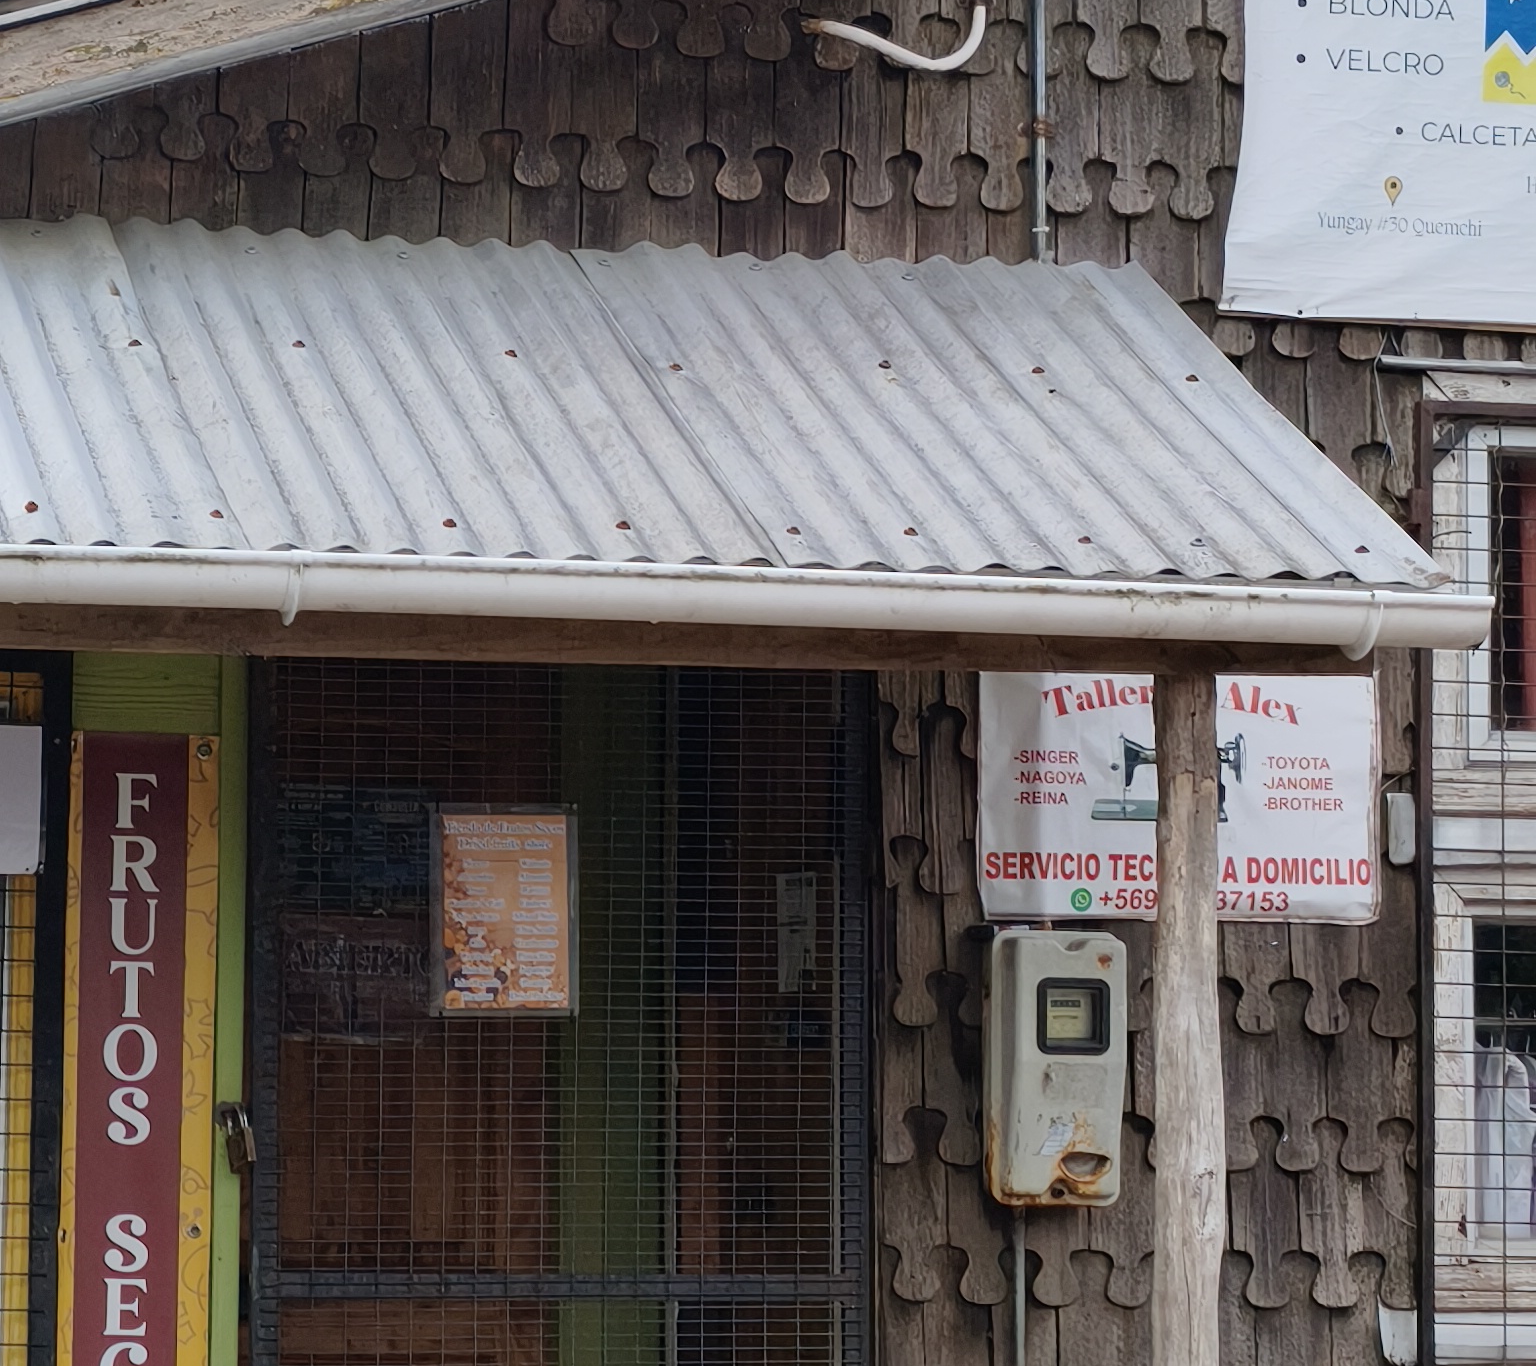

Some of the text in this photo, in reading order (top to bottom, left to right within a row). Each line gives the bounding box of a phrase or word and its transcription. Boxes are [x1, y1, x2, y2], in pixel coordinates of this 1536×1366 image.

[1326, 47, 1445, 77] VELCRO
[1420, 121, 1536, 147] CALCETA
[1317, 211, 1373, 235] Yungay
[1412, 218, 1482, 237] Quemchi
[1041, 678, 1302, 726] Taller Alex
[984, 851, 1101, 882] SERVICIO
[1222, 856, 1239, 884] A
[1246, 857, 1373, 886] DOMICILIO
[102, 772, 160, 1146] FRUTOS
